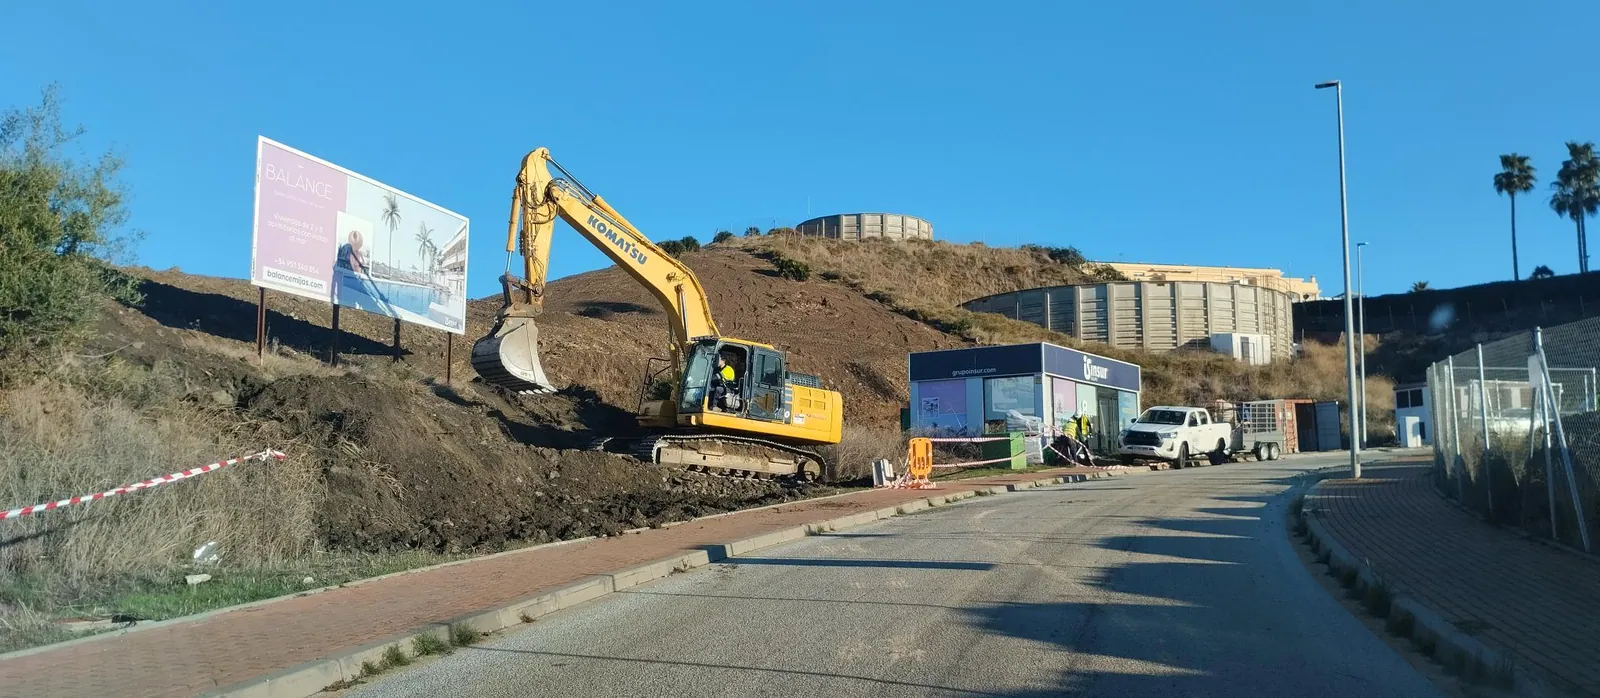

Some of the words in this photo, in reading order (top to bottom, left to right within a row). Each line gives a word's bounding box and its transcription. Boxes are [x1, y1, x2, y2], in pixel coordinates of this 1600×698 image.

[266, 163, 333, 201] BALANCE
[587, 214, 648, 265] KOMATSU
[267, 269, 324, 289] balancemijas.com
[952, 367, 997, 377] grupoinsur.com
